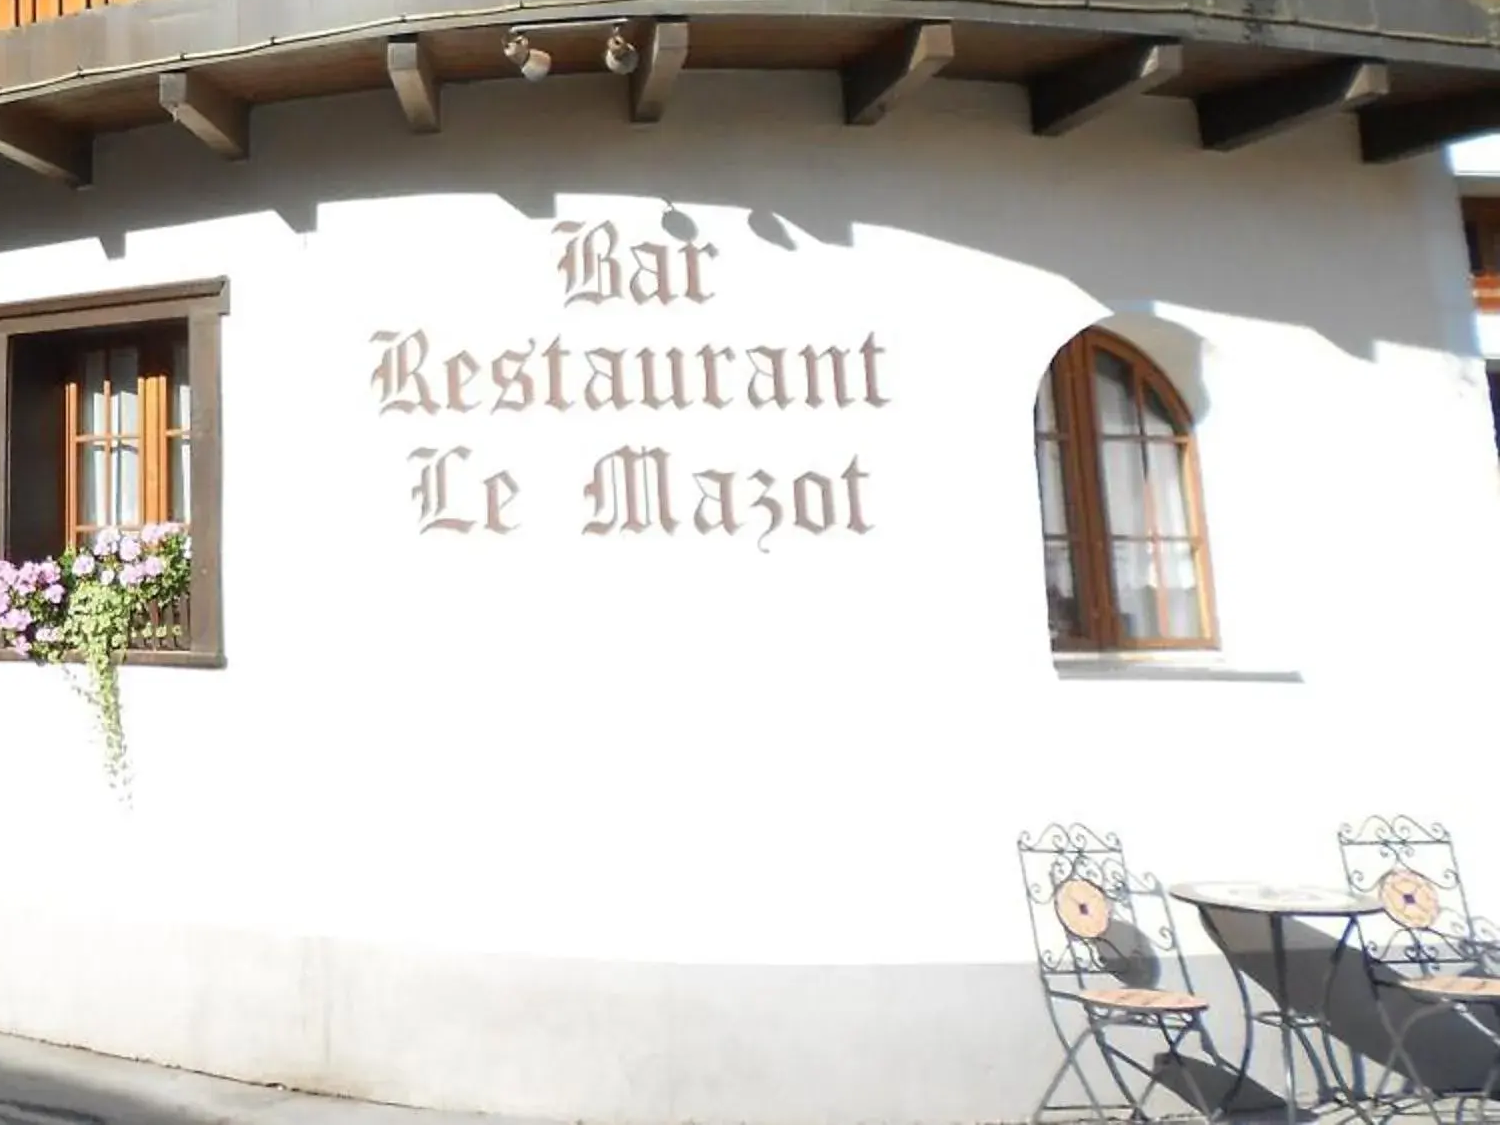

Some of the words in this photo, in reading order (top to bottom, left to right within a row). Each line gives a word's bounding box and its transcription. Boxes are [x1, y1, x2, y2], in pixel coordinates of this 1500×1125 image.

[551, 220, 720, 308] Bar
[369, 328, 893, 416] Restaurant
[406, 445, 522, 536] Le
[582, 444, 877, 555] Mazot
